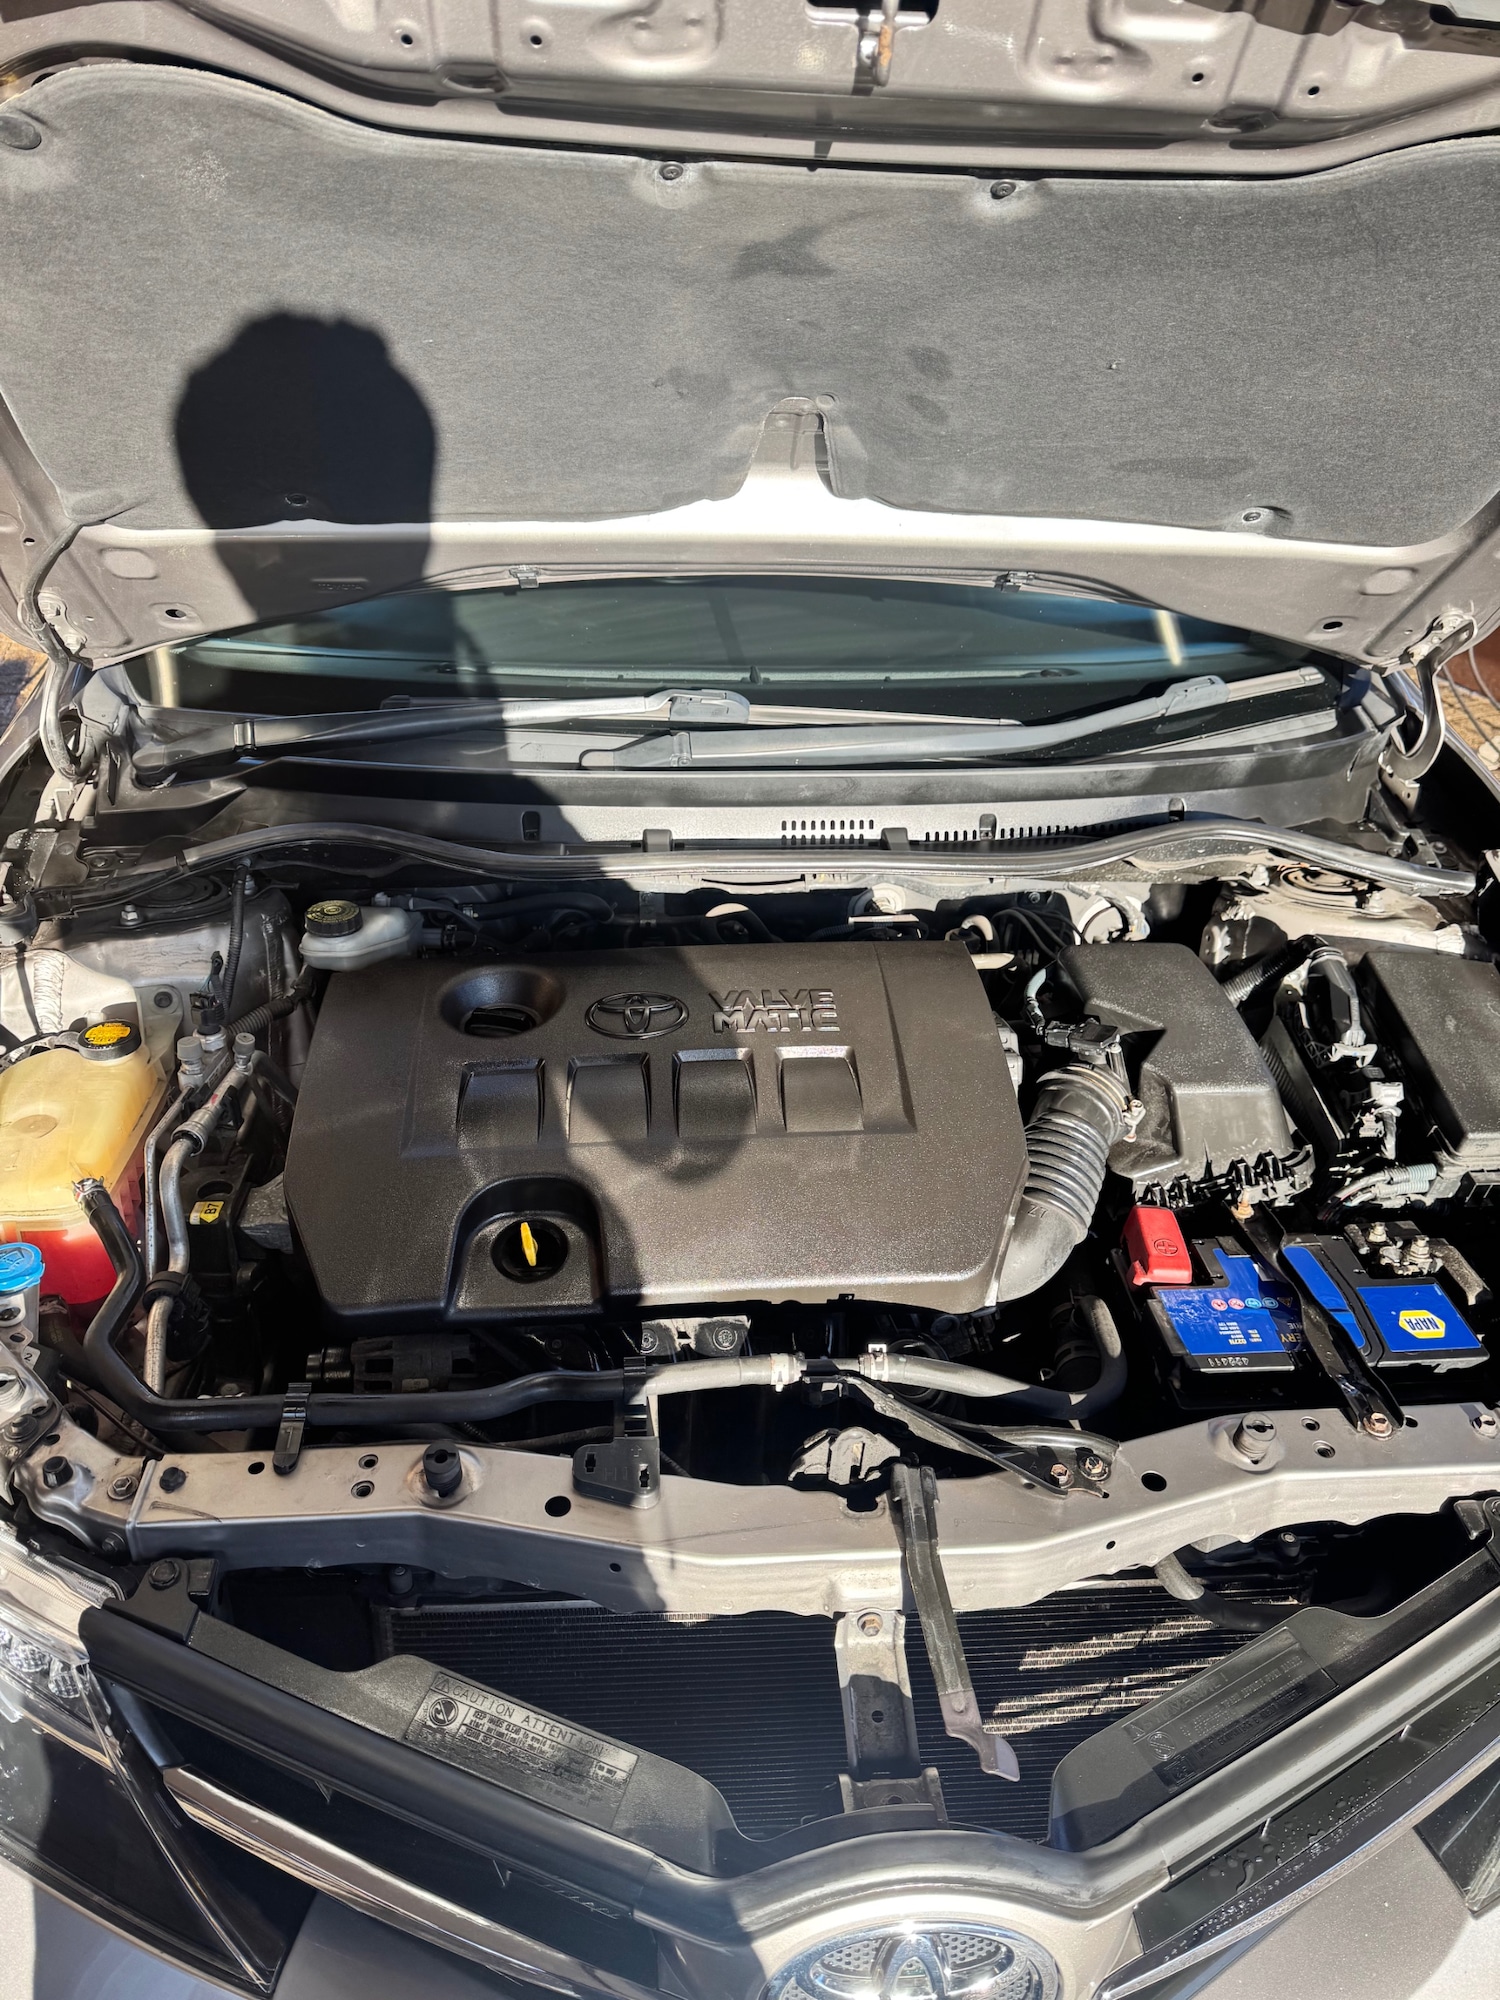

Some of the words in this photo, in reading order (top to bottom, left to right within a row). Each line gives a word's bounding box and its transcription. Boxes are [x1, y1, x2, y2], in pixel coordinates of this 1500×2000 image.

[708, 988, 837, 1011] VALVE
[712, 1007, 841, 1033] MATIC
[1403, 1316, 1441, 1331] NAPA
[23, 1352, 33, 1362] 2
[452, 1684, 516, 1720] CAUTION
[521, 1714, 605, 1755] ATTENTION
